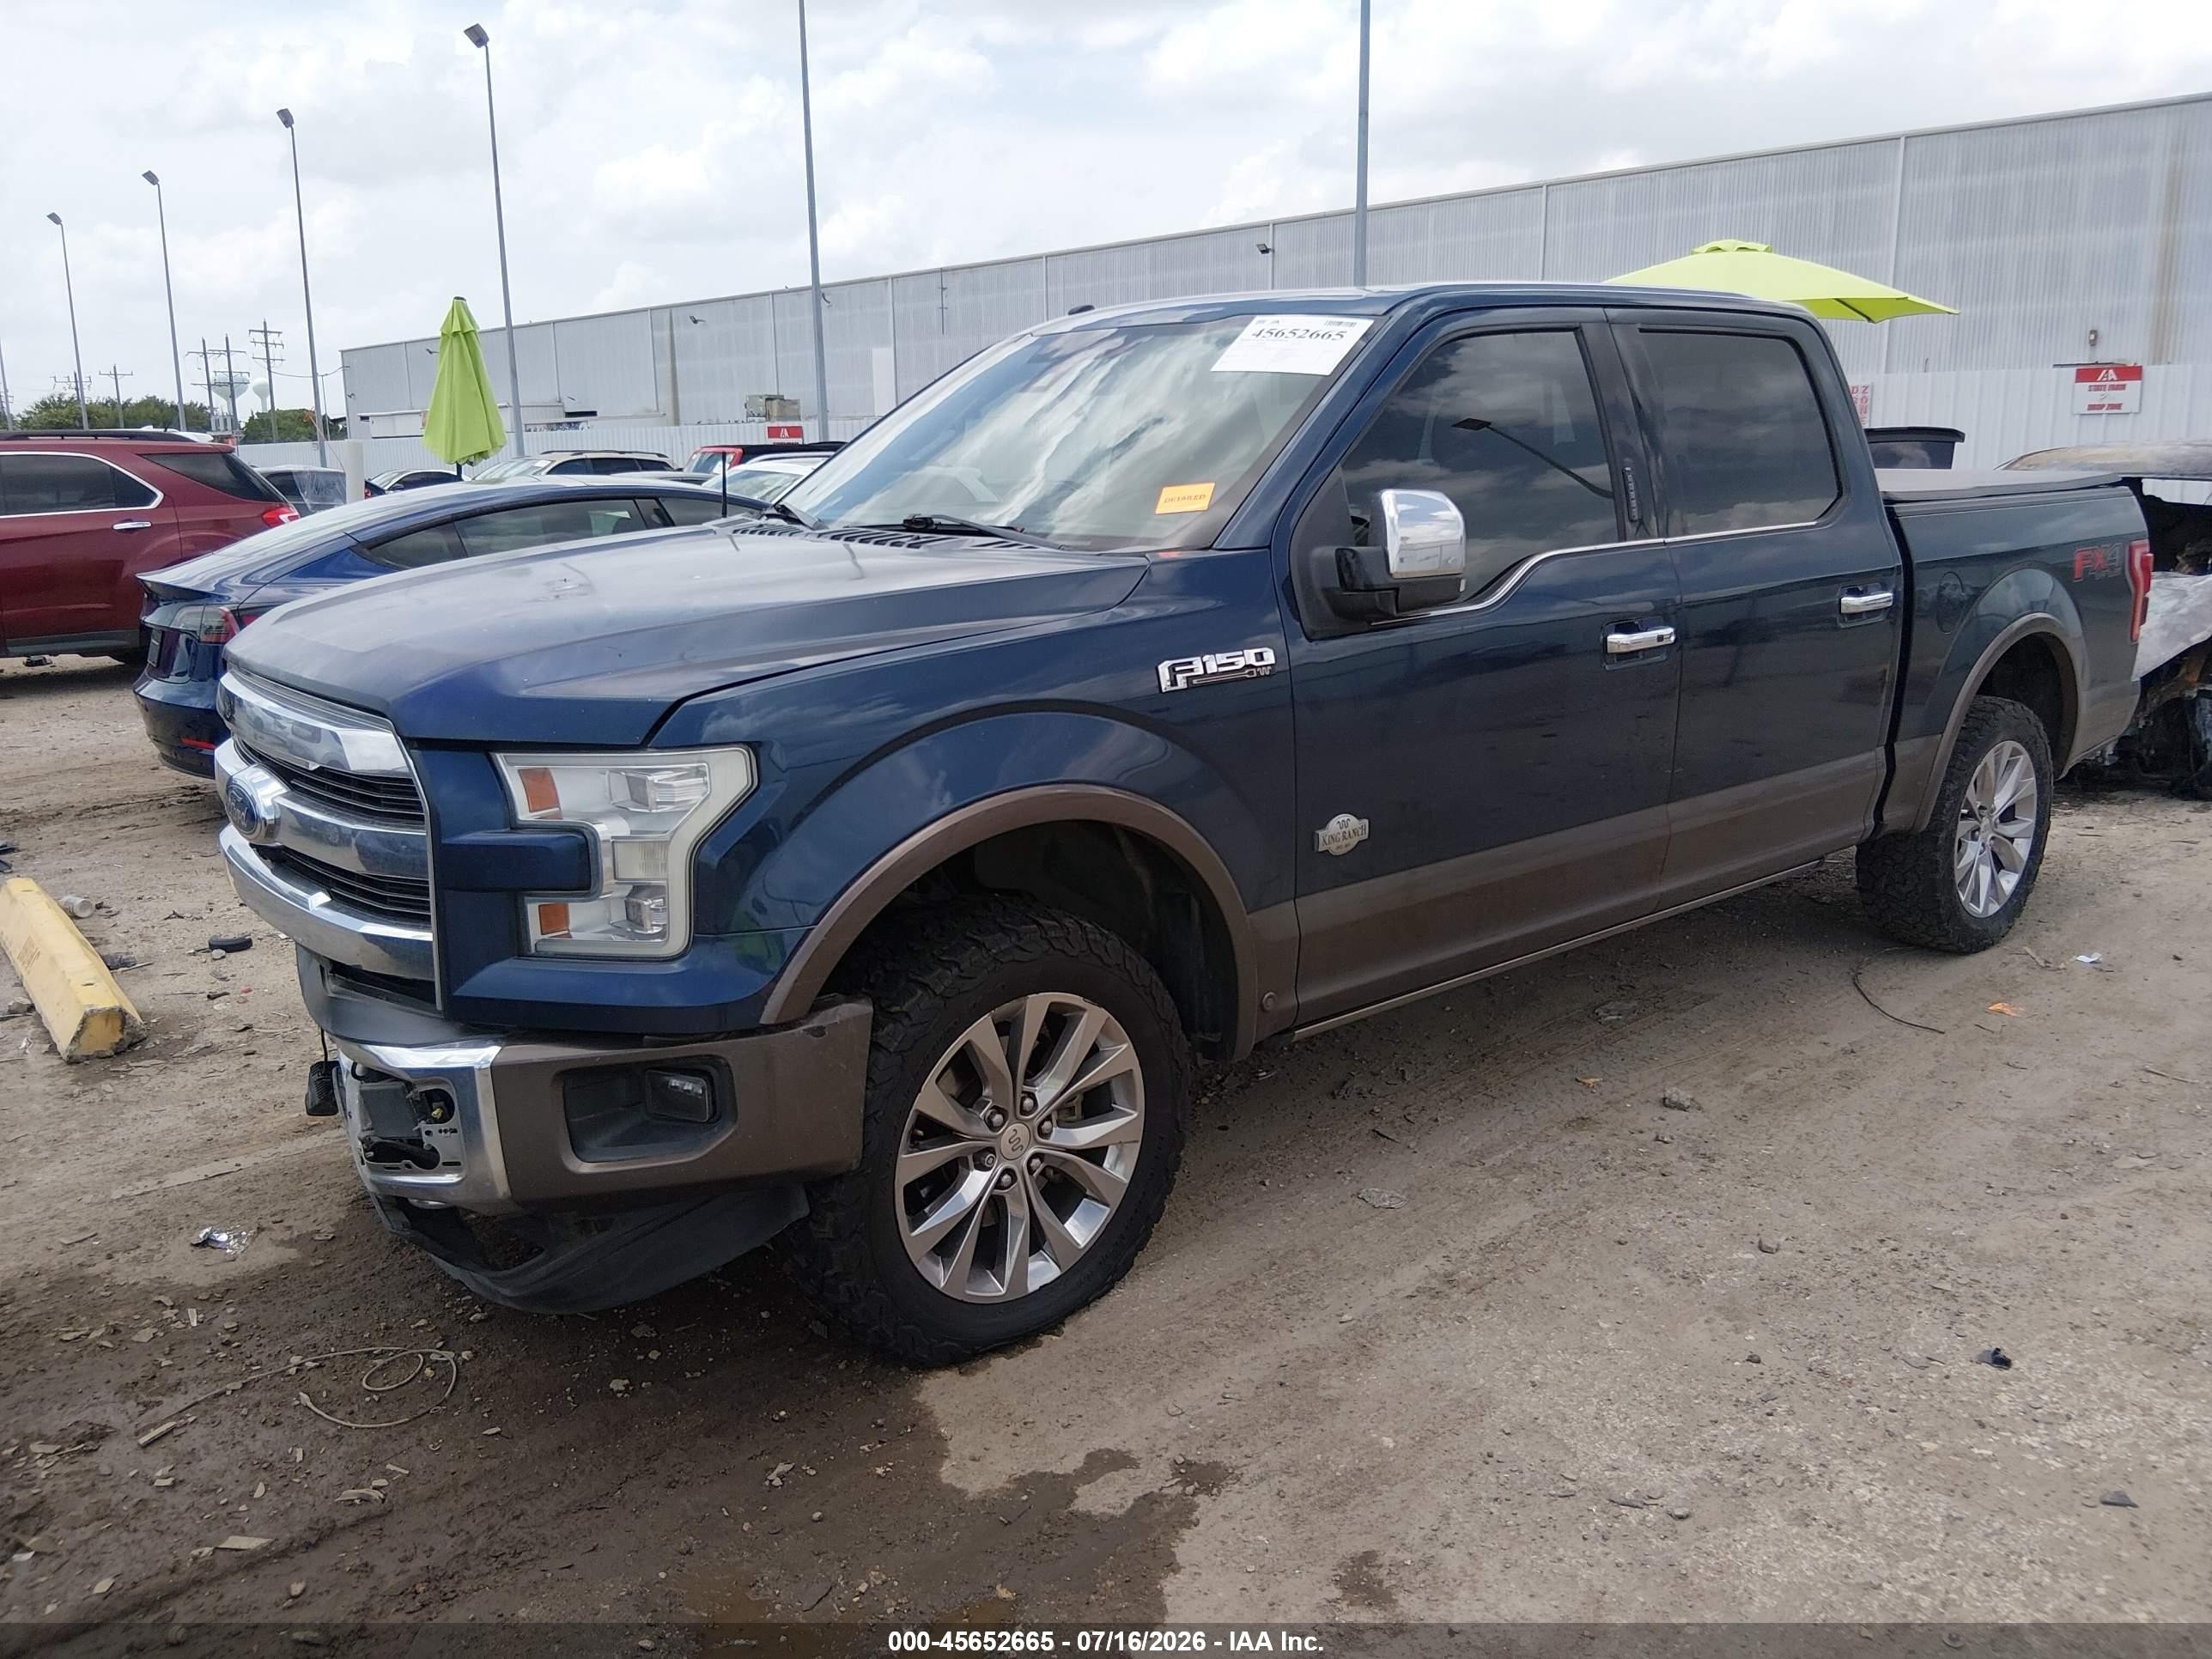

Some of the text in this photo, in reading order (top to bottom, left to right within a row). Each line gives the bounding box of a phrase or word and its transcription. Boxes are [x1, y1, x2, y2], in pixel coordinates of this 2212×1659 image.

[1250, 328, 1347, 341] 45652665
[2074, 543, 2125, 582] FX4
[1322, 823, 1367, 848] KING RANCH
